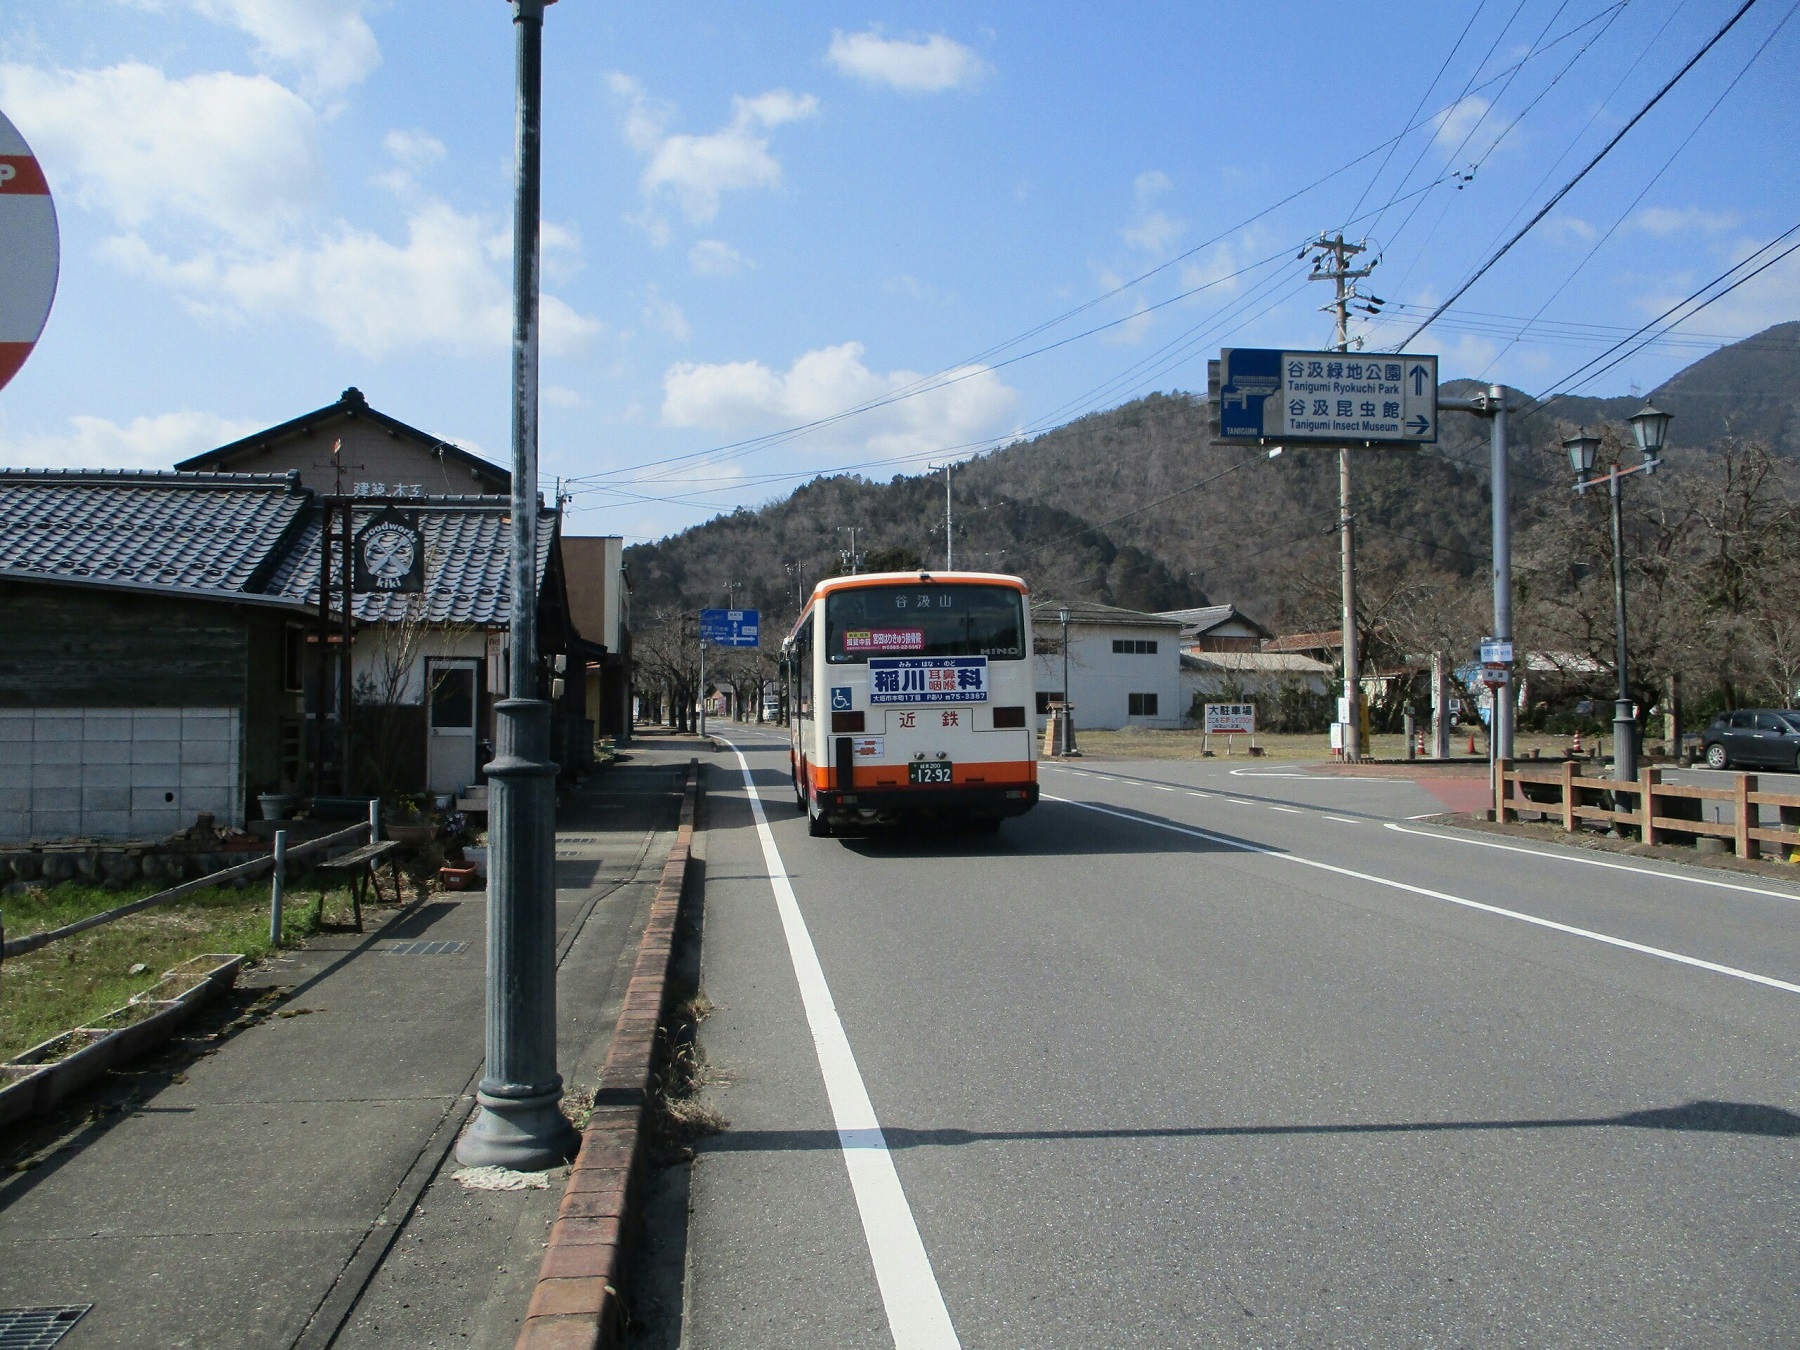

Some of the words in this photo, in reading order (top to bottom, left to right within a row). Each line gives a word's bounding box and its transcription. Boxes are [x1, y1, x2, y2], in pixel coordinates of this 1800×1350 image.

[1288, 361, 1401, 381] 谷汲緑地公園
[1288, 380, 1331, 394] Tanigumi
[1333, 382, 1375, 395] Ryokuchi
[1378, 383, 1399, 394] Park
[1289, 399, 1400, 419] 谷汲昆虫館
[1289, 419, 1331, 431] Tanigumi
[1333, 420, 1360, 431] Insect
[1362, 421, 1398, 432] Museum
[361, 521, 418, 544] woodworks
[376, 577, 401, 589] kiki
[895, 594, 952, 608] 谷汲山
[981, 647, 1018, 655] HINO
[957, 668, 983, 691] 科
[1208, 705, 1253, 716] 大駐車場
[899, 711, 959, 729] 近鉄
[918, 768, 951, 783] 12-92
